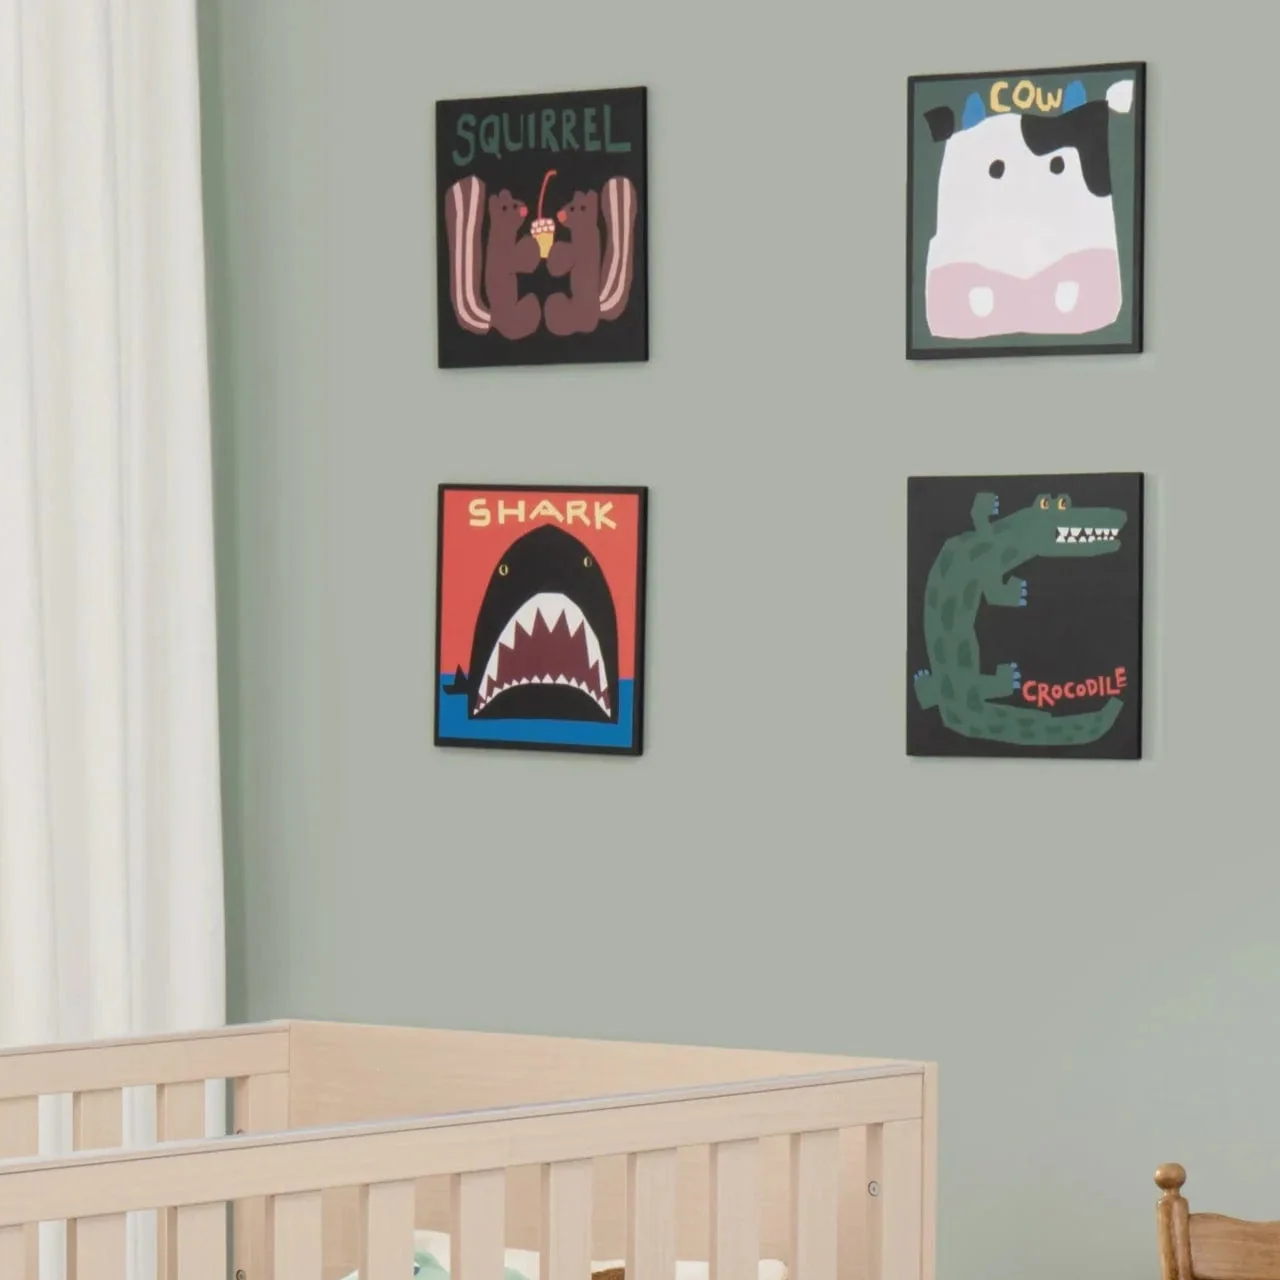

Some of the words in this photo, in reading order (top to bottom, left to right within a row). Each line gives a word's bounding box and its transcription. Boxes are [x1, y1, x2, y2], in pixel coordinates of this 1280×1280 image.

[990, 80, 1063, 113] COW
[452, 104, 632, 167] SQUIRREL
[468, 498, 618, 530] SHARK
[1022, 666, 1128, 707] CROCODILE
